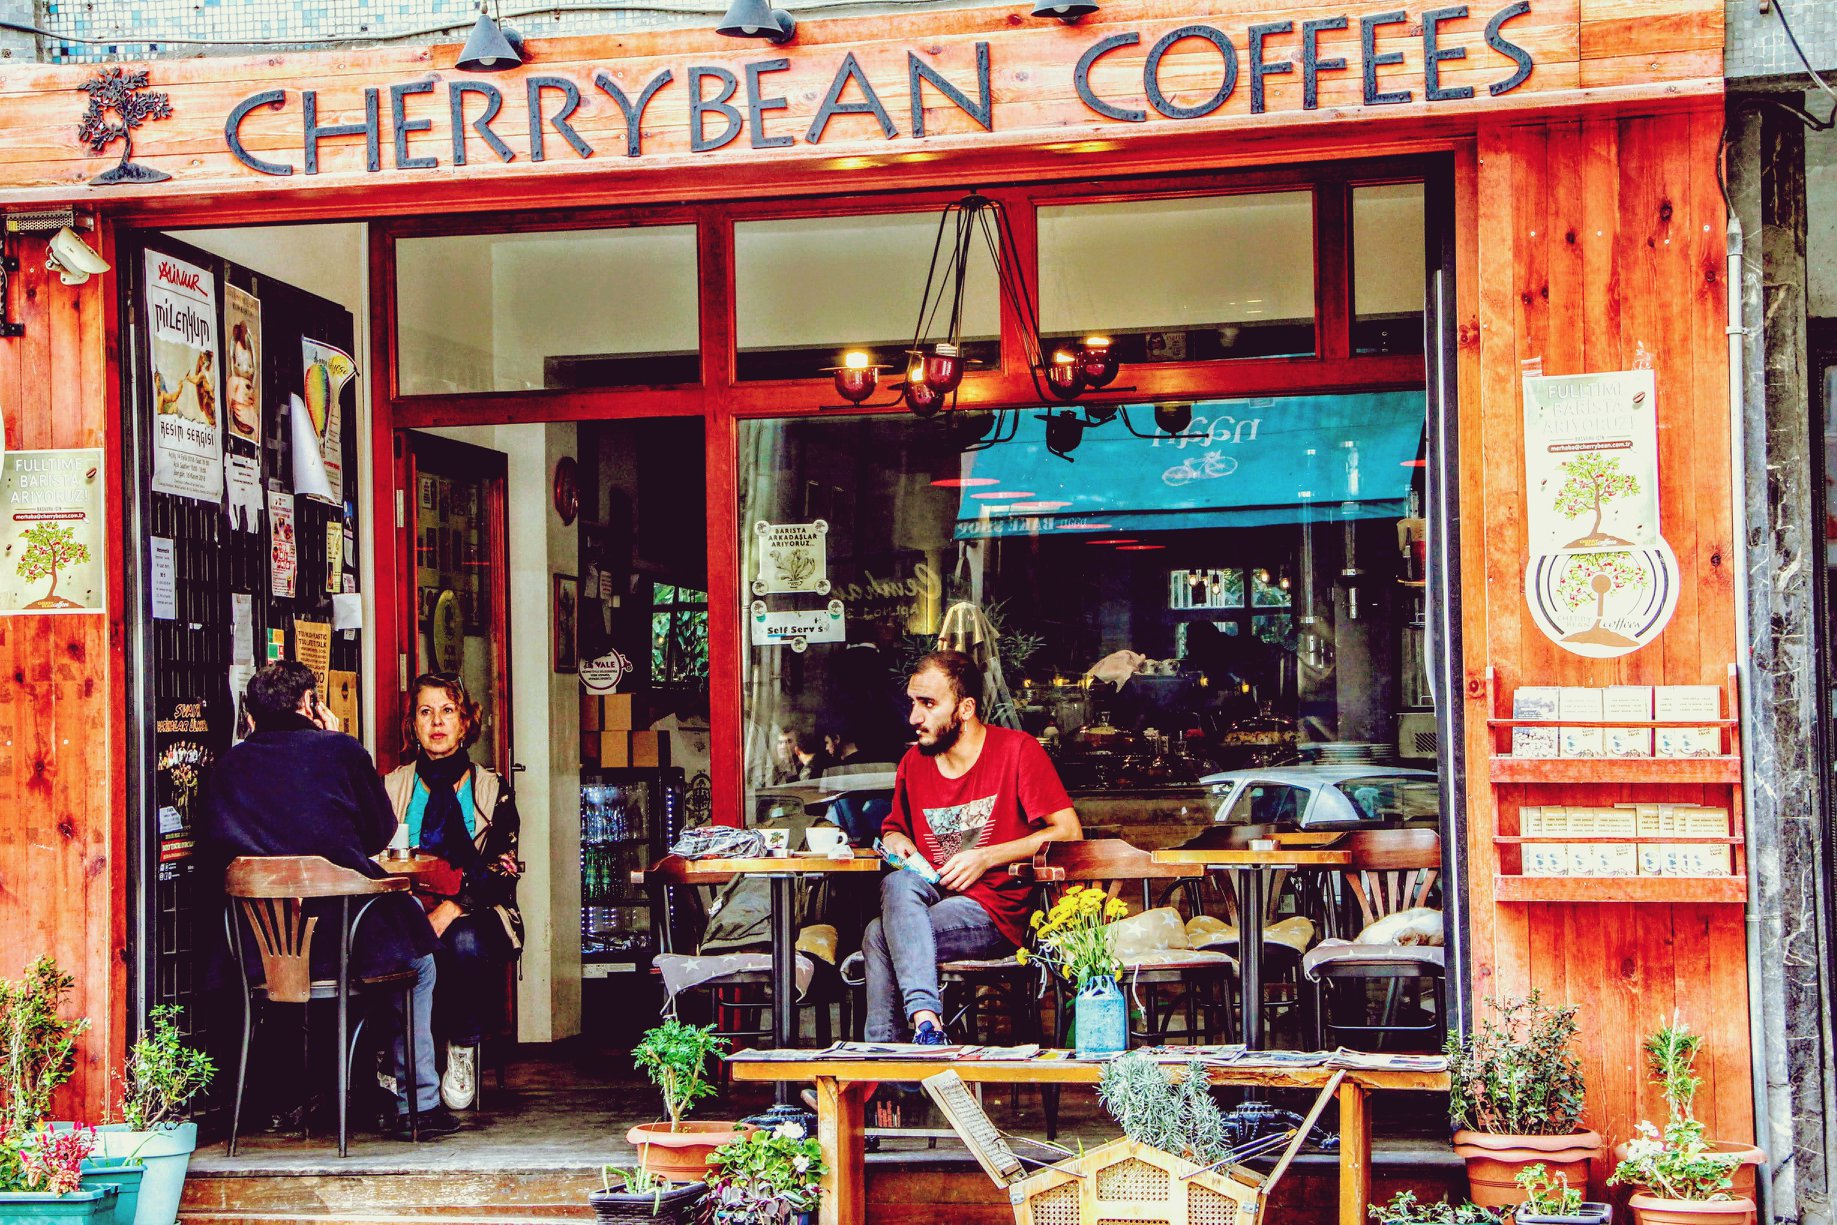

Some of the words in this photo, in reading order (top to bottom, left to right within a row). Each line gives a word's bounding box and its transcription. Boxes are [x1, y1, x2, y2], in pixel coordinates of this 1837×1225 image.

[1073, 1, 1532, 122] COFFEES
[15, 458, 83, 472] FULLTIME
[768, 533, 818, 541] ARKADAŞLAR
[767, 626, 788, 634] Self
[790, 626, 824, 634] Servs
[595, 661, 616, 669] VALE
